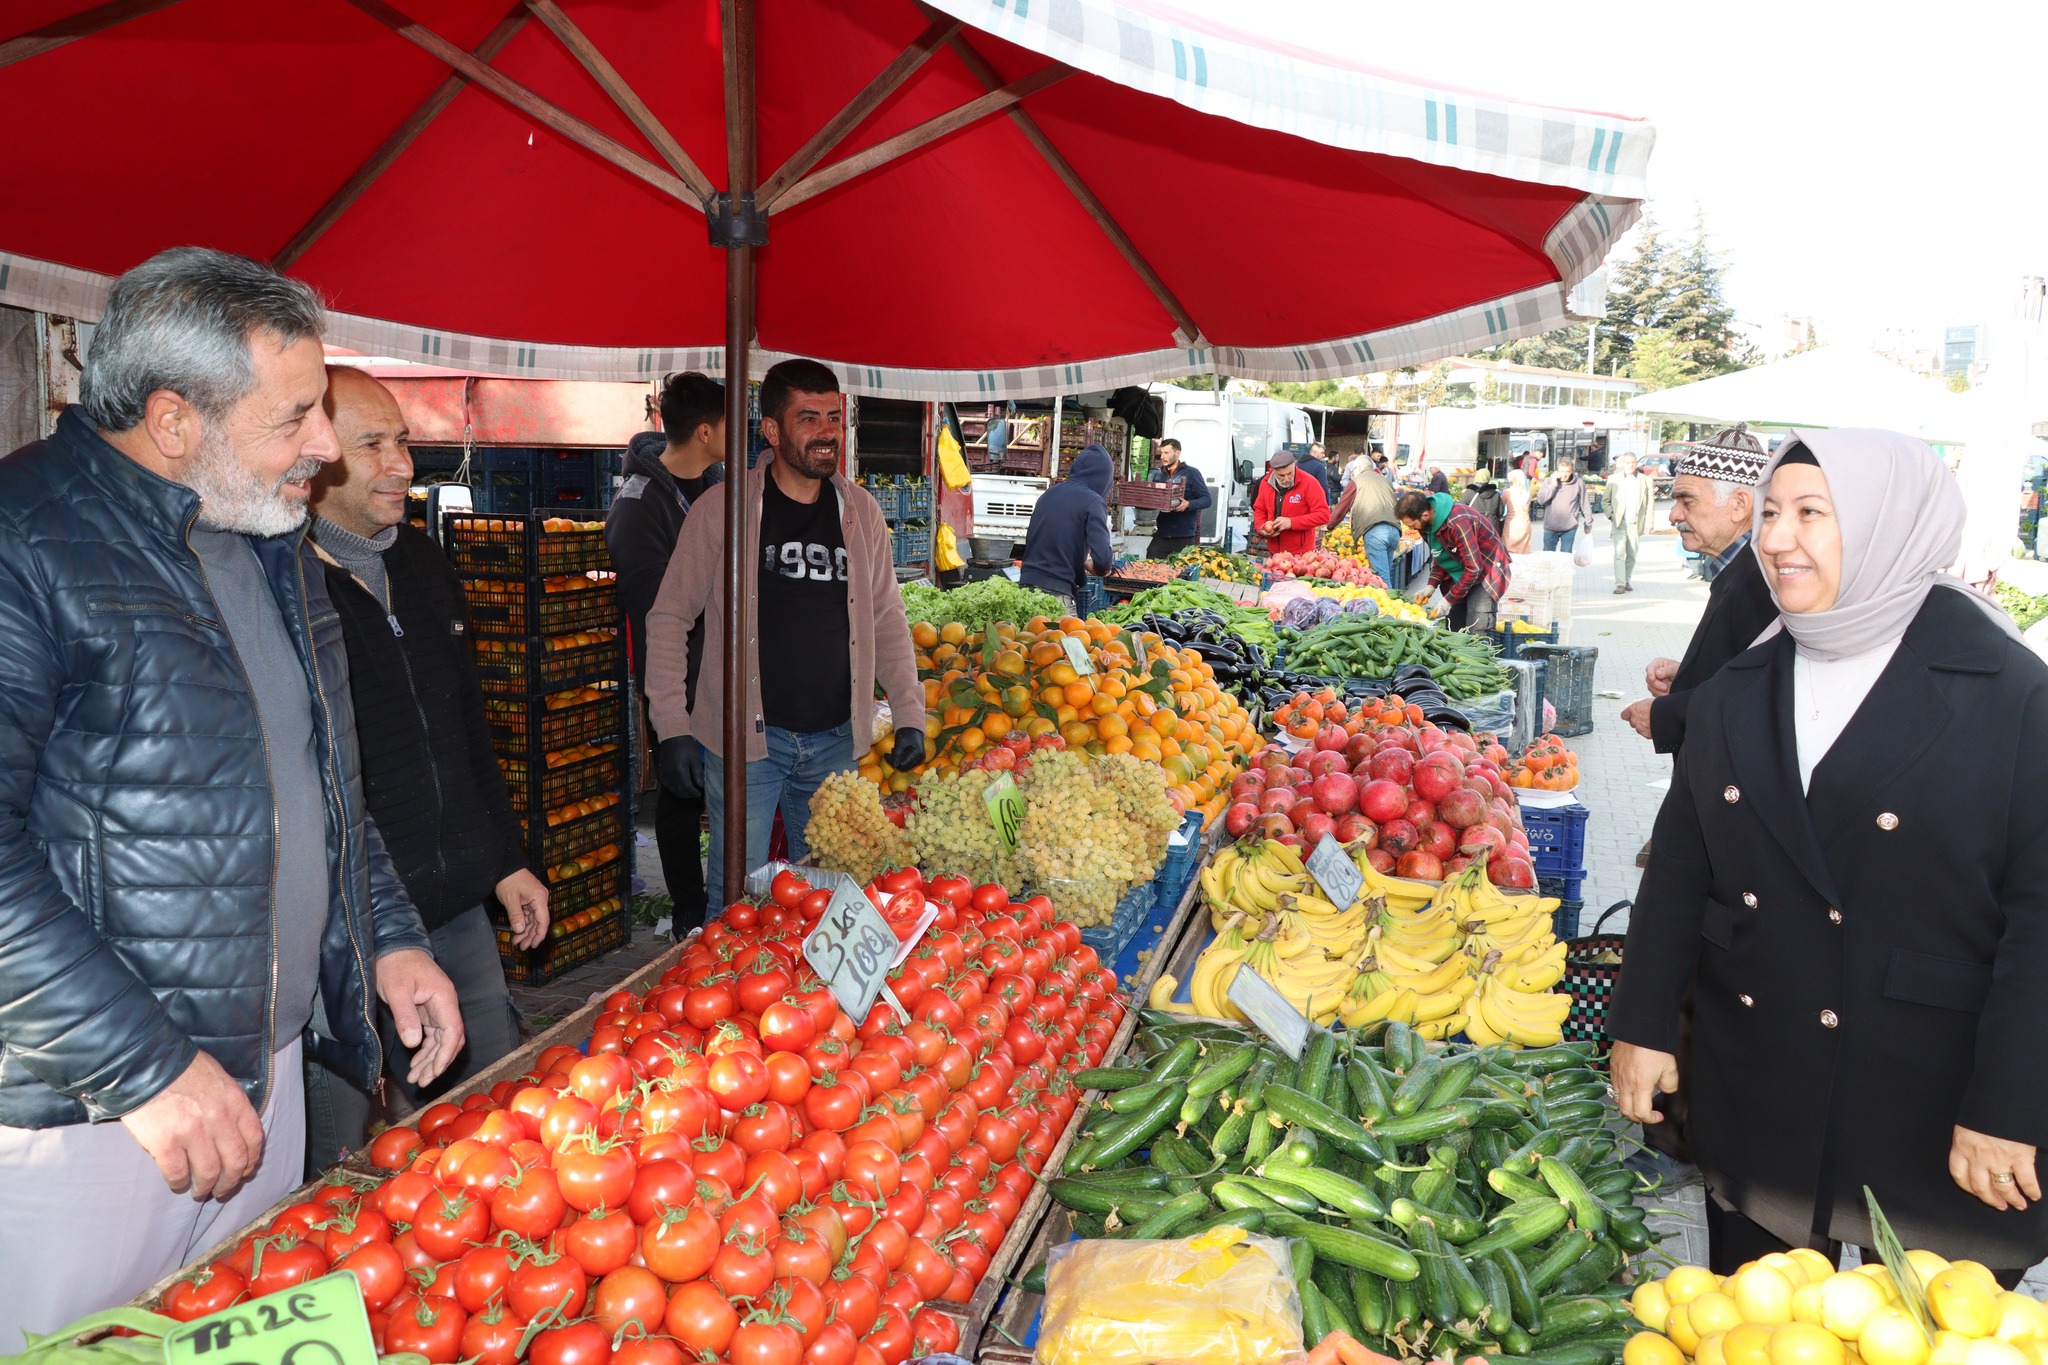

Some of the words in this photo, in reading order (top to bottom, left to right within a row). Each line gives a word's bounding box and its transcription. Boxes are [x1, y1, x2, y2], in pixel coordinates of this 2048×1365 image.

[1525, 832, 1554, 842] ÖM
[1327, 860, 1355, 901] 80
[811, 931, 845, 982] 3
[846, 925, 886, 1007] 100
